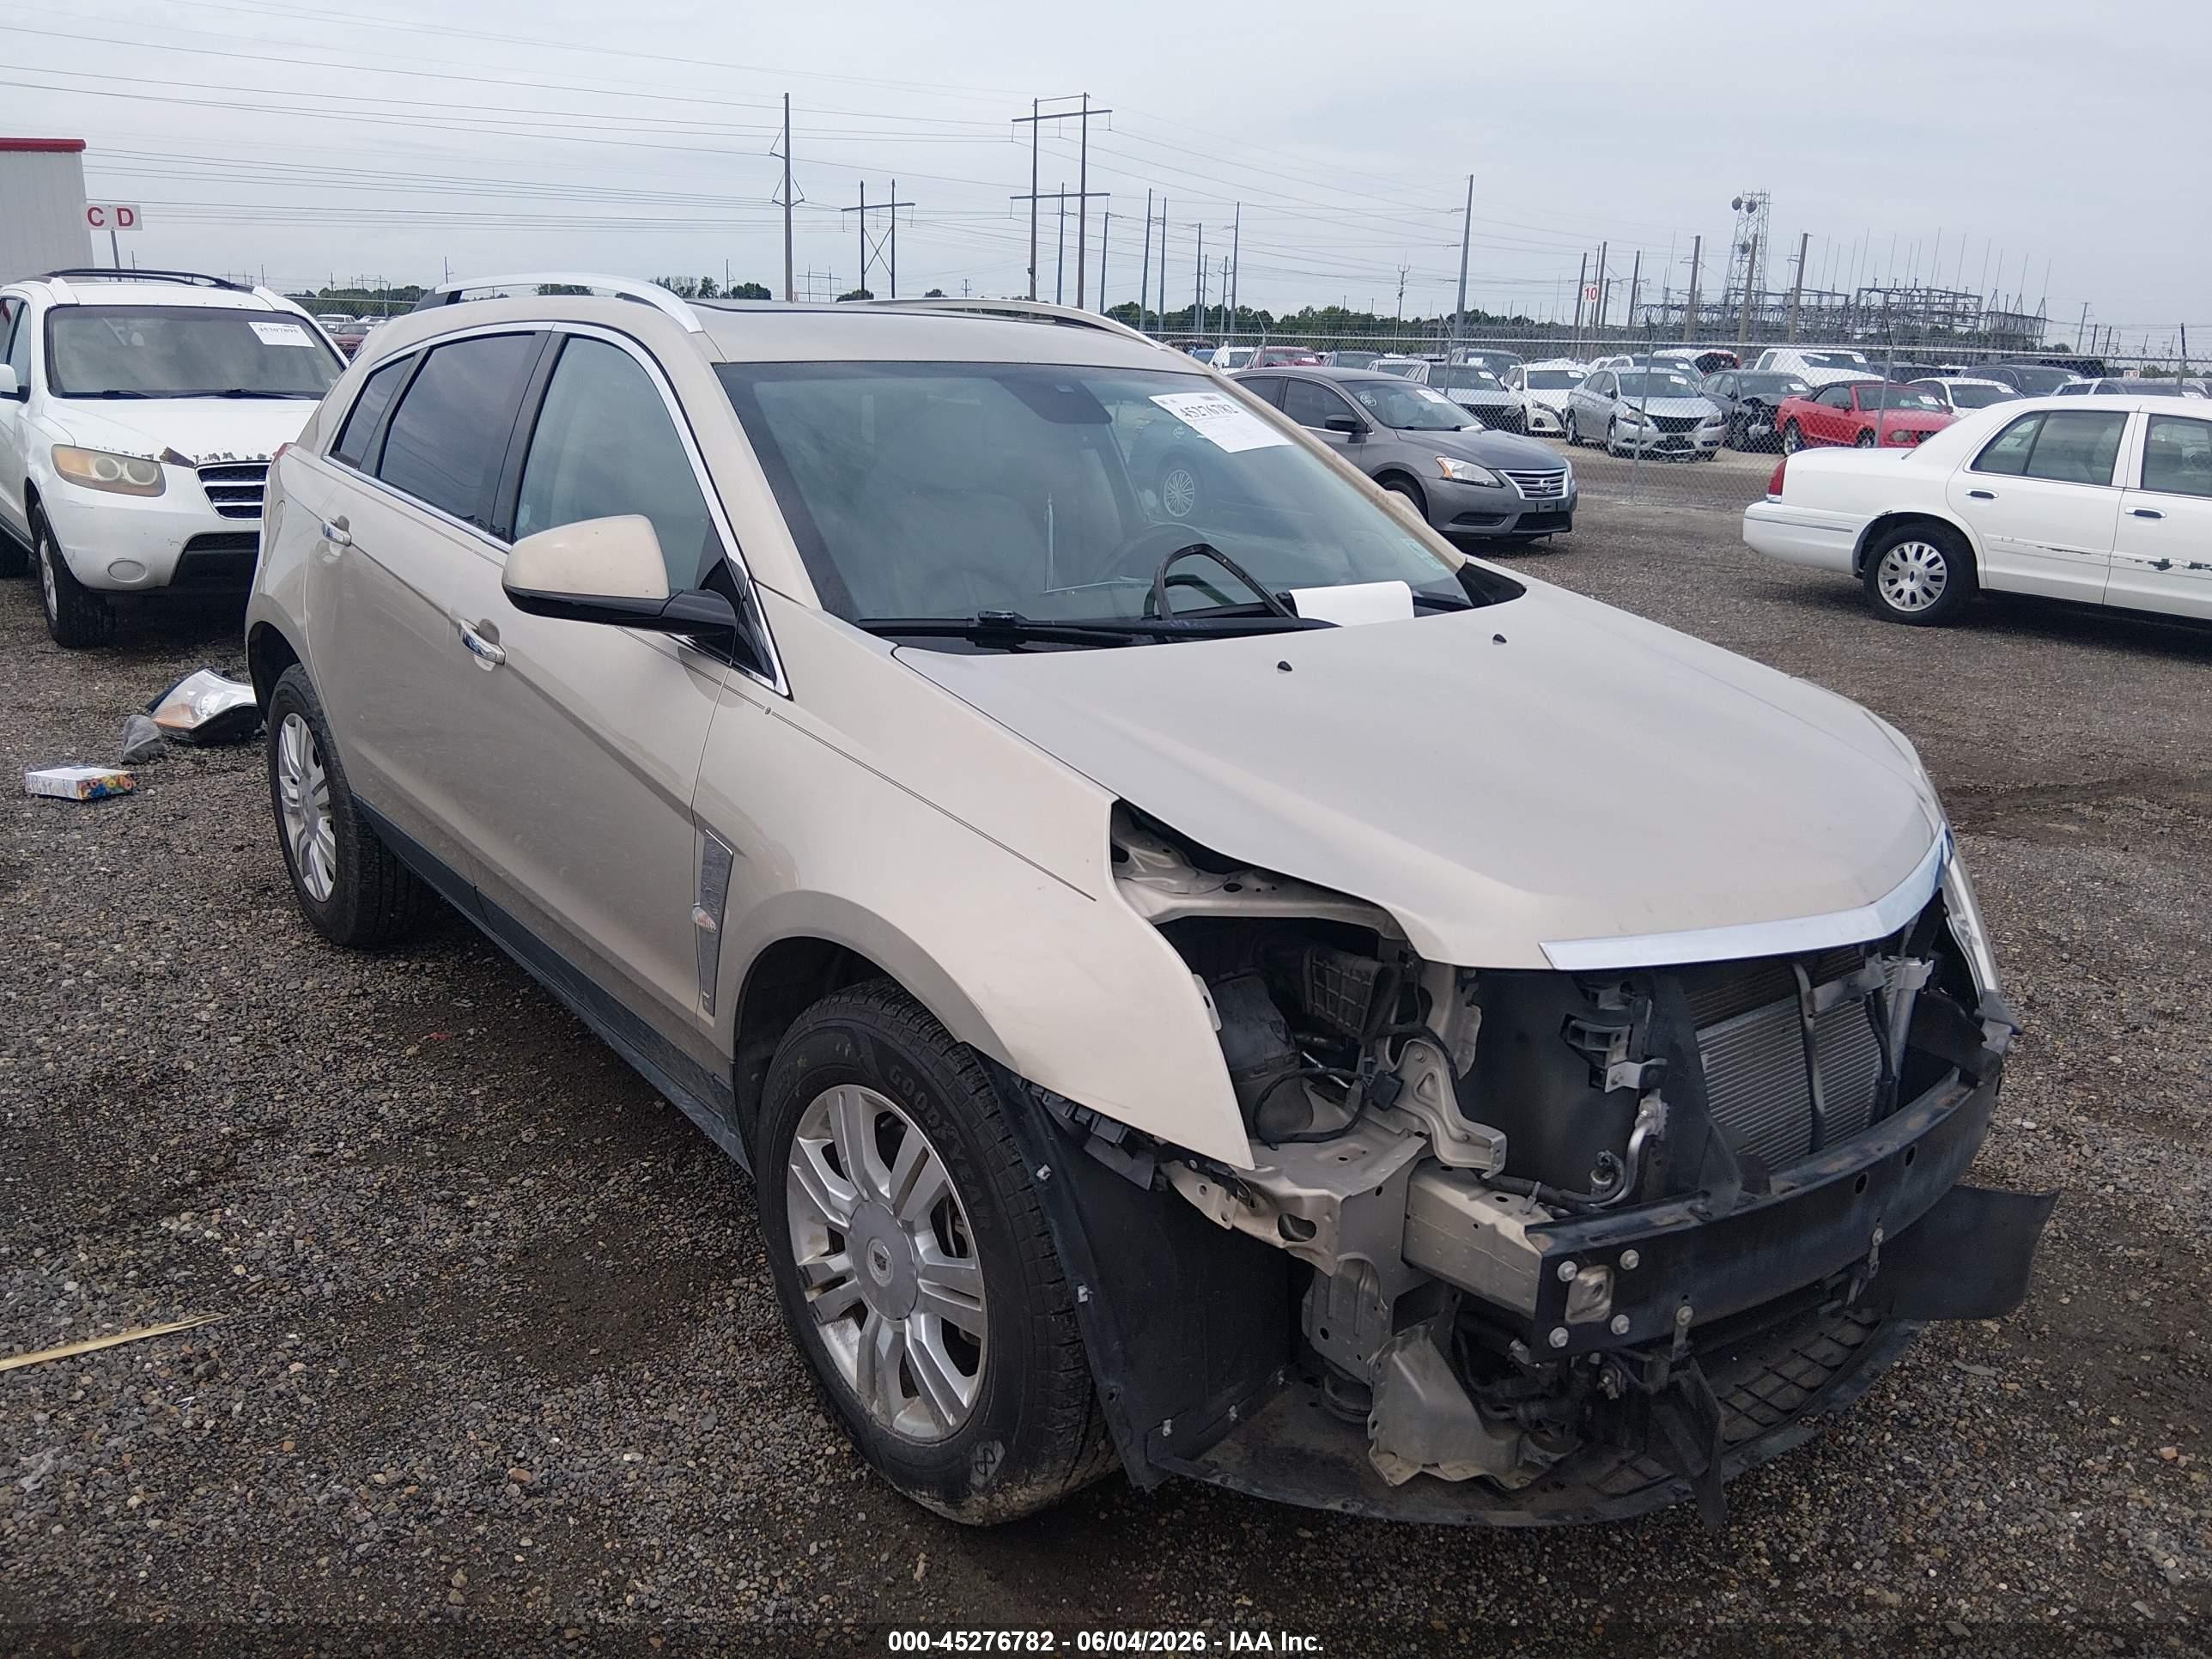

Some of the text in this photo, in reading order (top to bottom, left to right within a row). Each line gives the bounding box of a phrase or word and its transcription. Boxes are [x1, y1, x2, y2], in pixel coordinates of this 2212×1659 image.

[87, 206, 134, 227] C D
[1584, 287, 1598, 301] 10
[1178, 404, 1239, 418] 45276782
